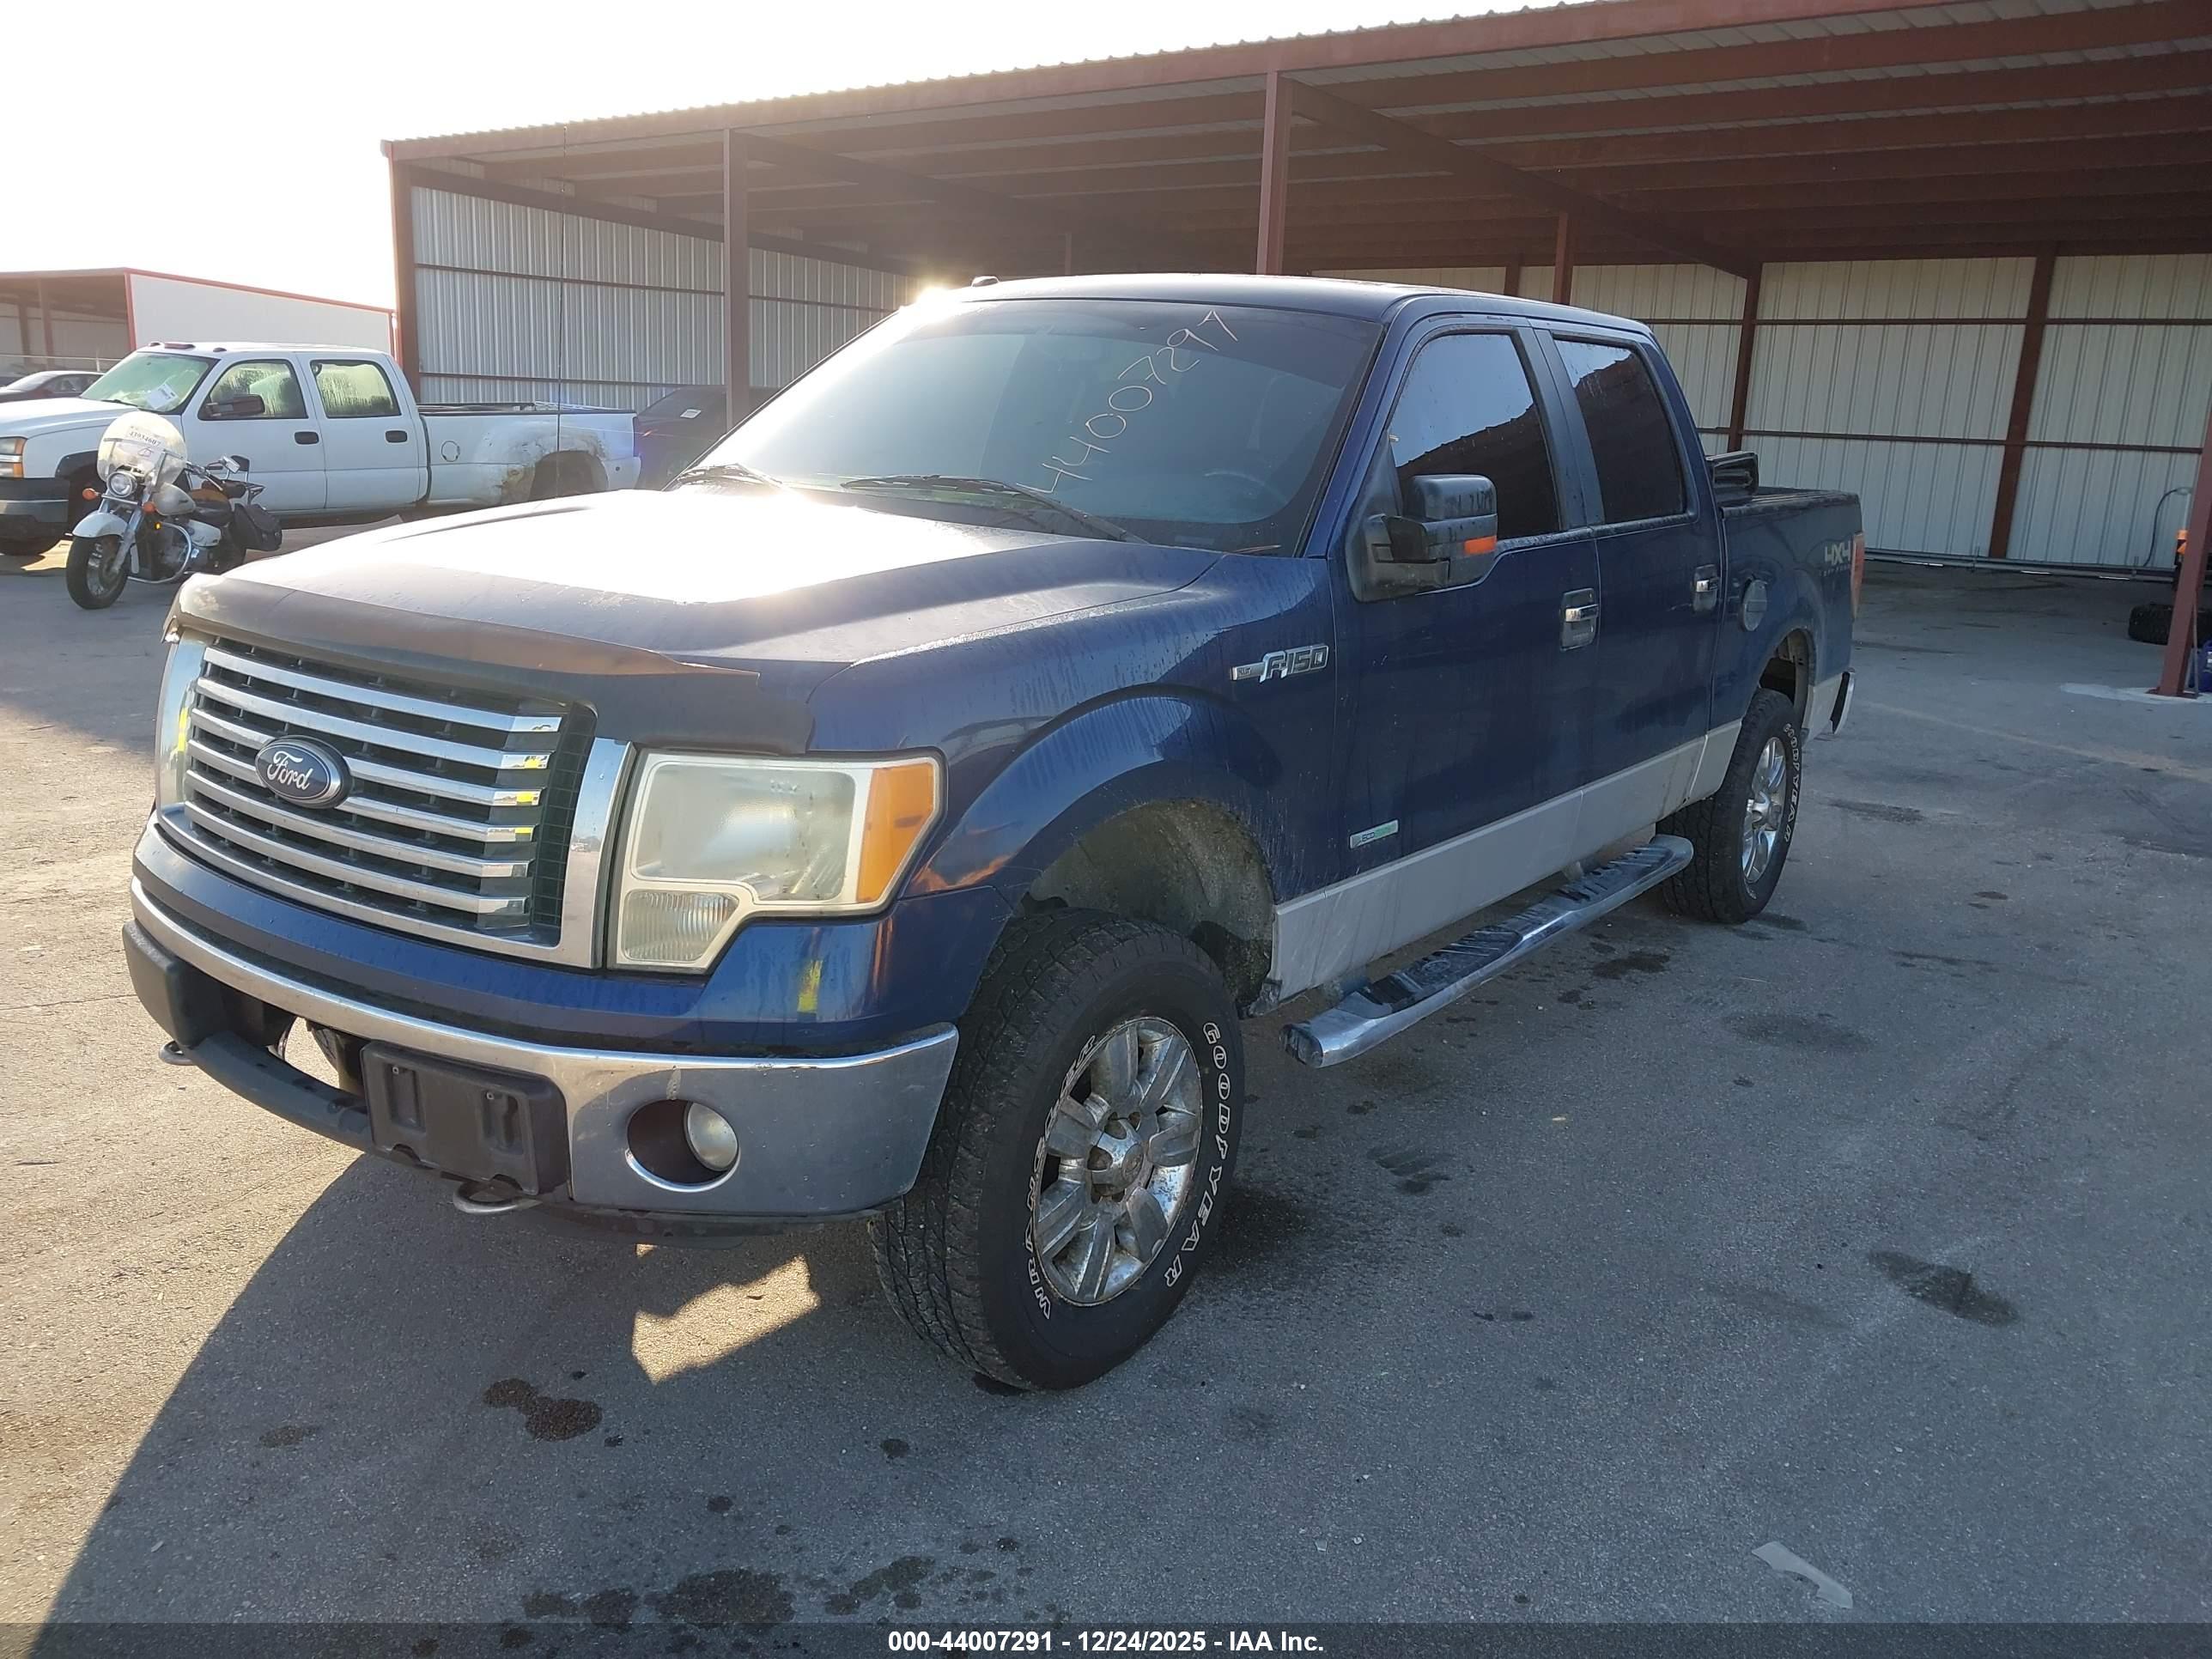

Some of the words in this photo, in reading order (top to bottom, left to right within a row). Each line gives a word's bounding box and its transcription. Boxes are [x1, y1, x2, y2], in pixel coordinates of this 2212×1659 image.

[267, 750, 313, 791] Ford
[1784, 723, 1800, 842] GOODYEAR
[1164, 1023, 1231, 1287] GOODYEAR
